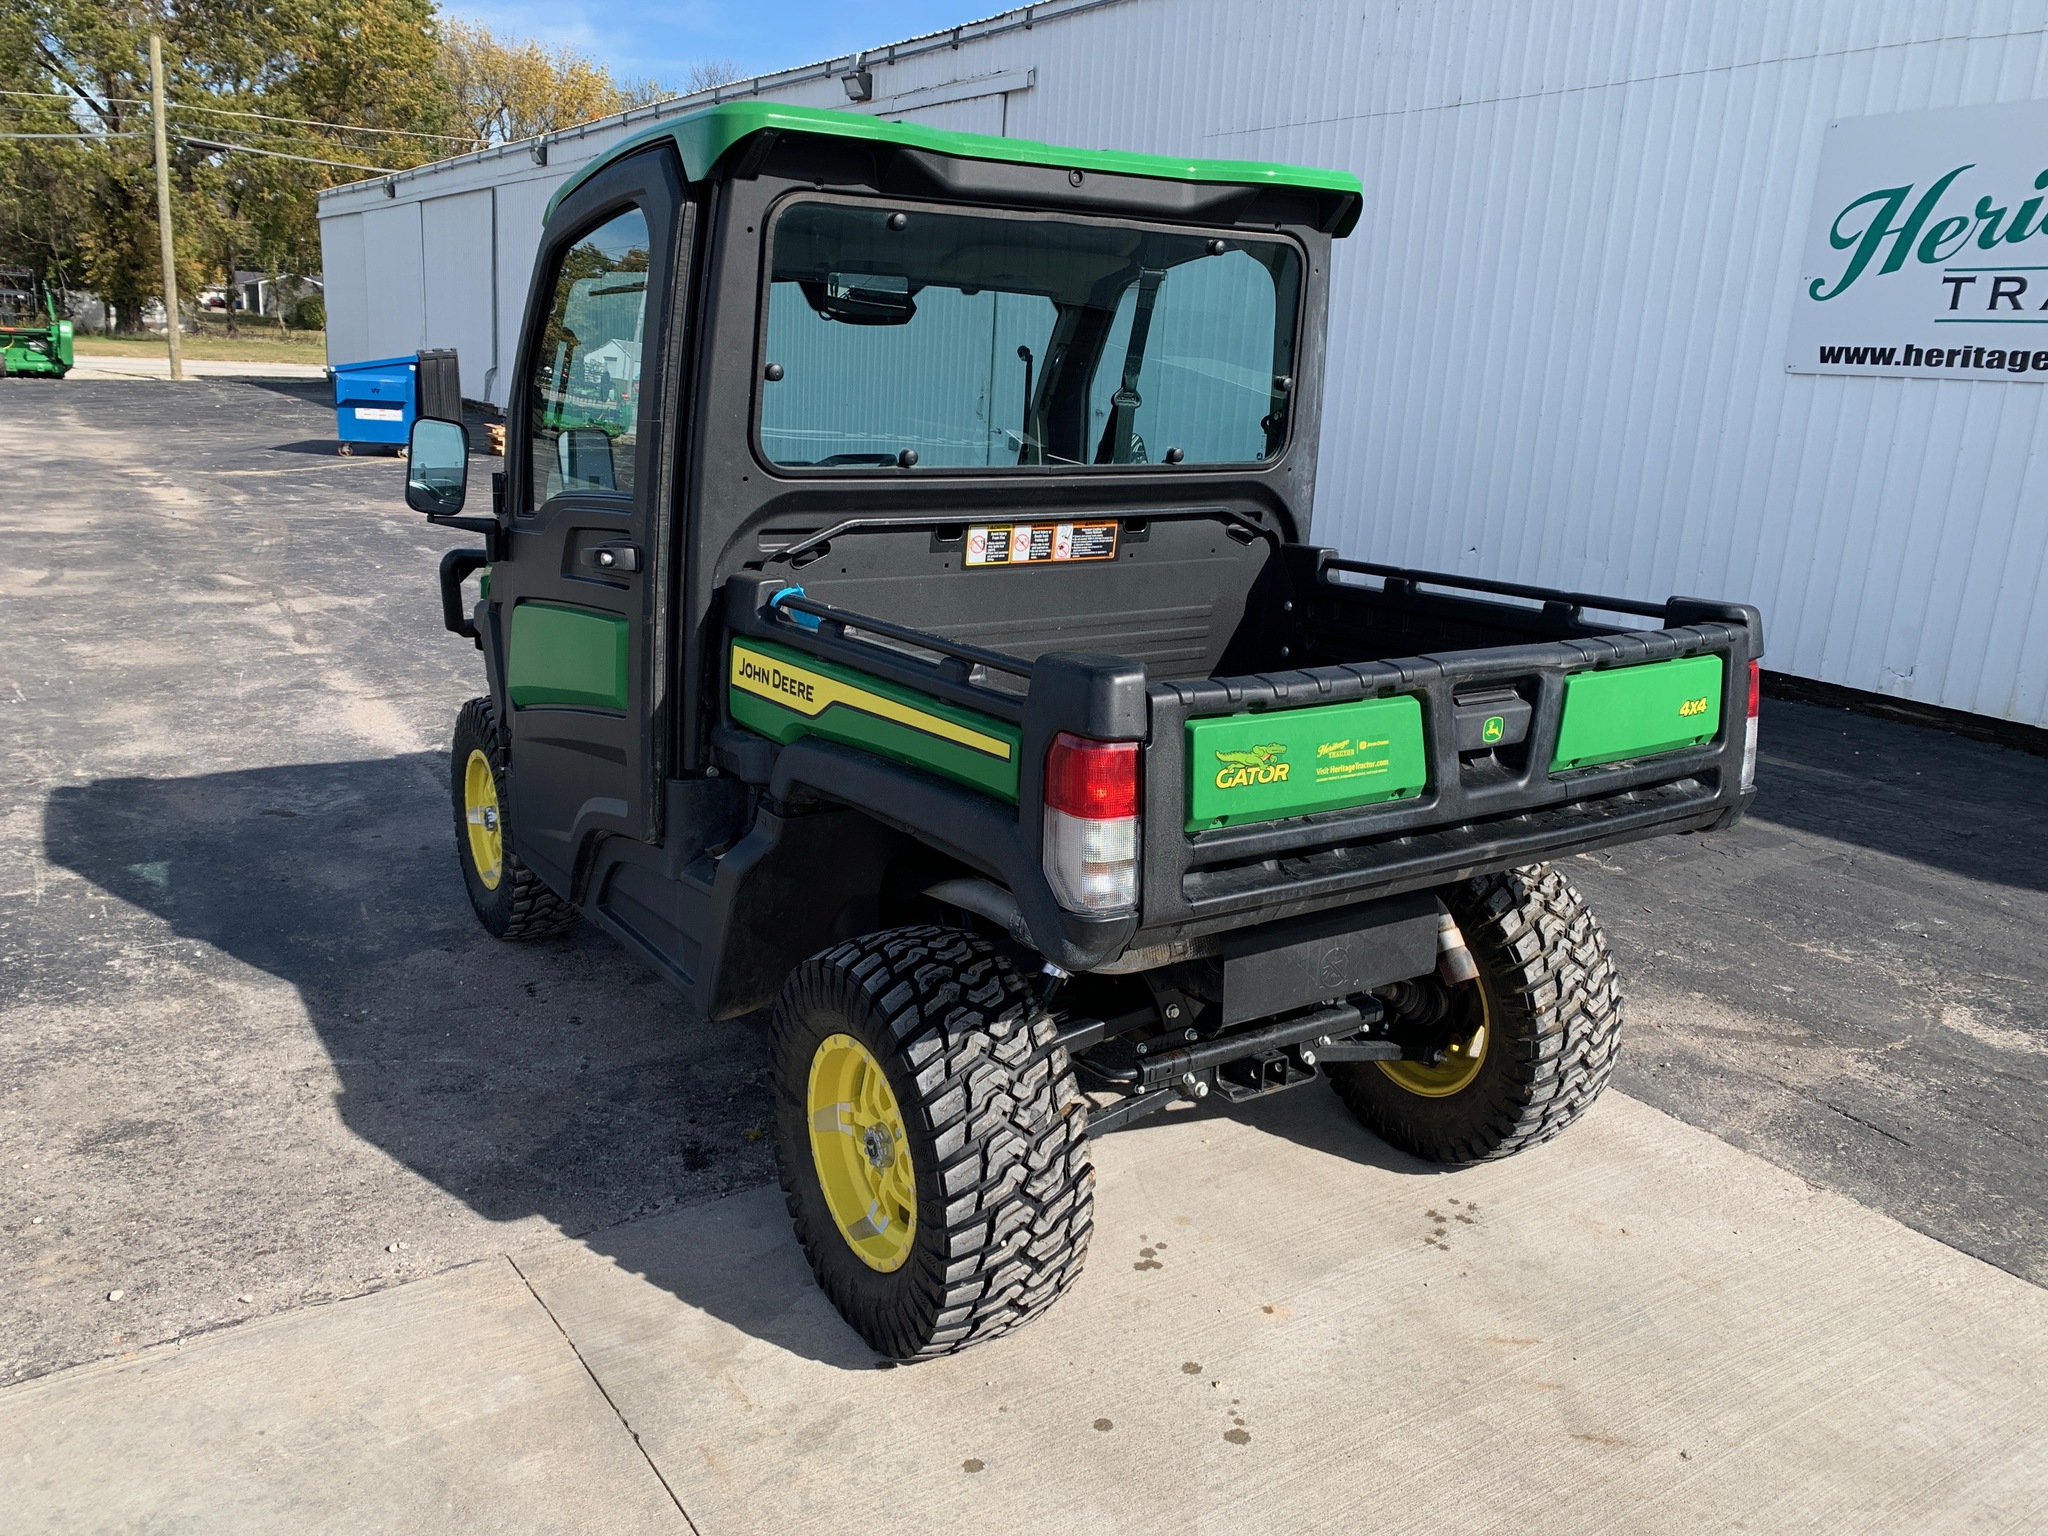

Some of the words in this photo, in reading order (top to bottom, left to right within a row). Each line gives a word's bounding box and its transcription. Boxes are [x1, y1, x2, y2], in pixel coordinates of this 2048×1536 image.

[1809, 163, 2048, 301] Heri
[1942, 276, 2048, 311] TR
[739, 657, 770, 685] JOHN
[773, 668, 814, 702] DEERE
[1215, 763, 1290, 789] GATOR
[1316, 767, 1329, 775] Visit
[1330, 759, 1389, 773] HeritageTractor.com
